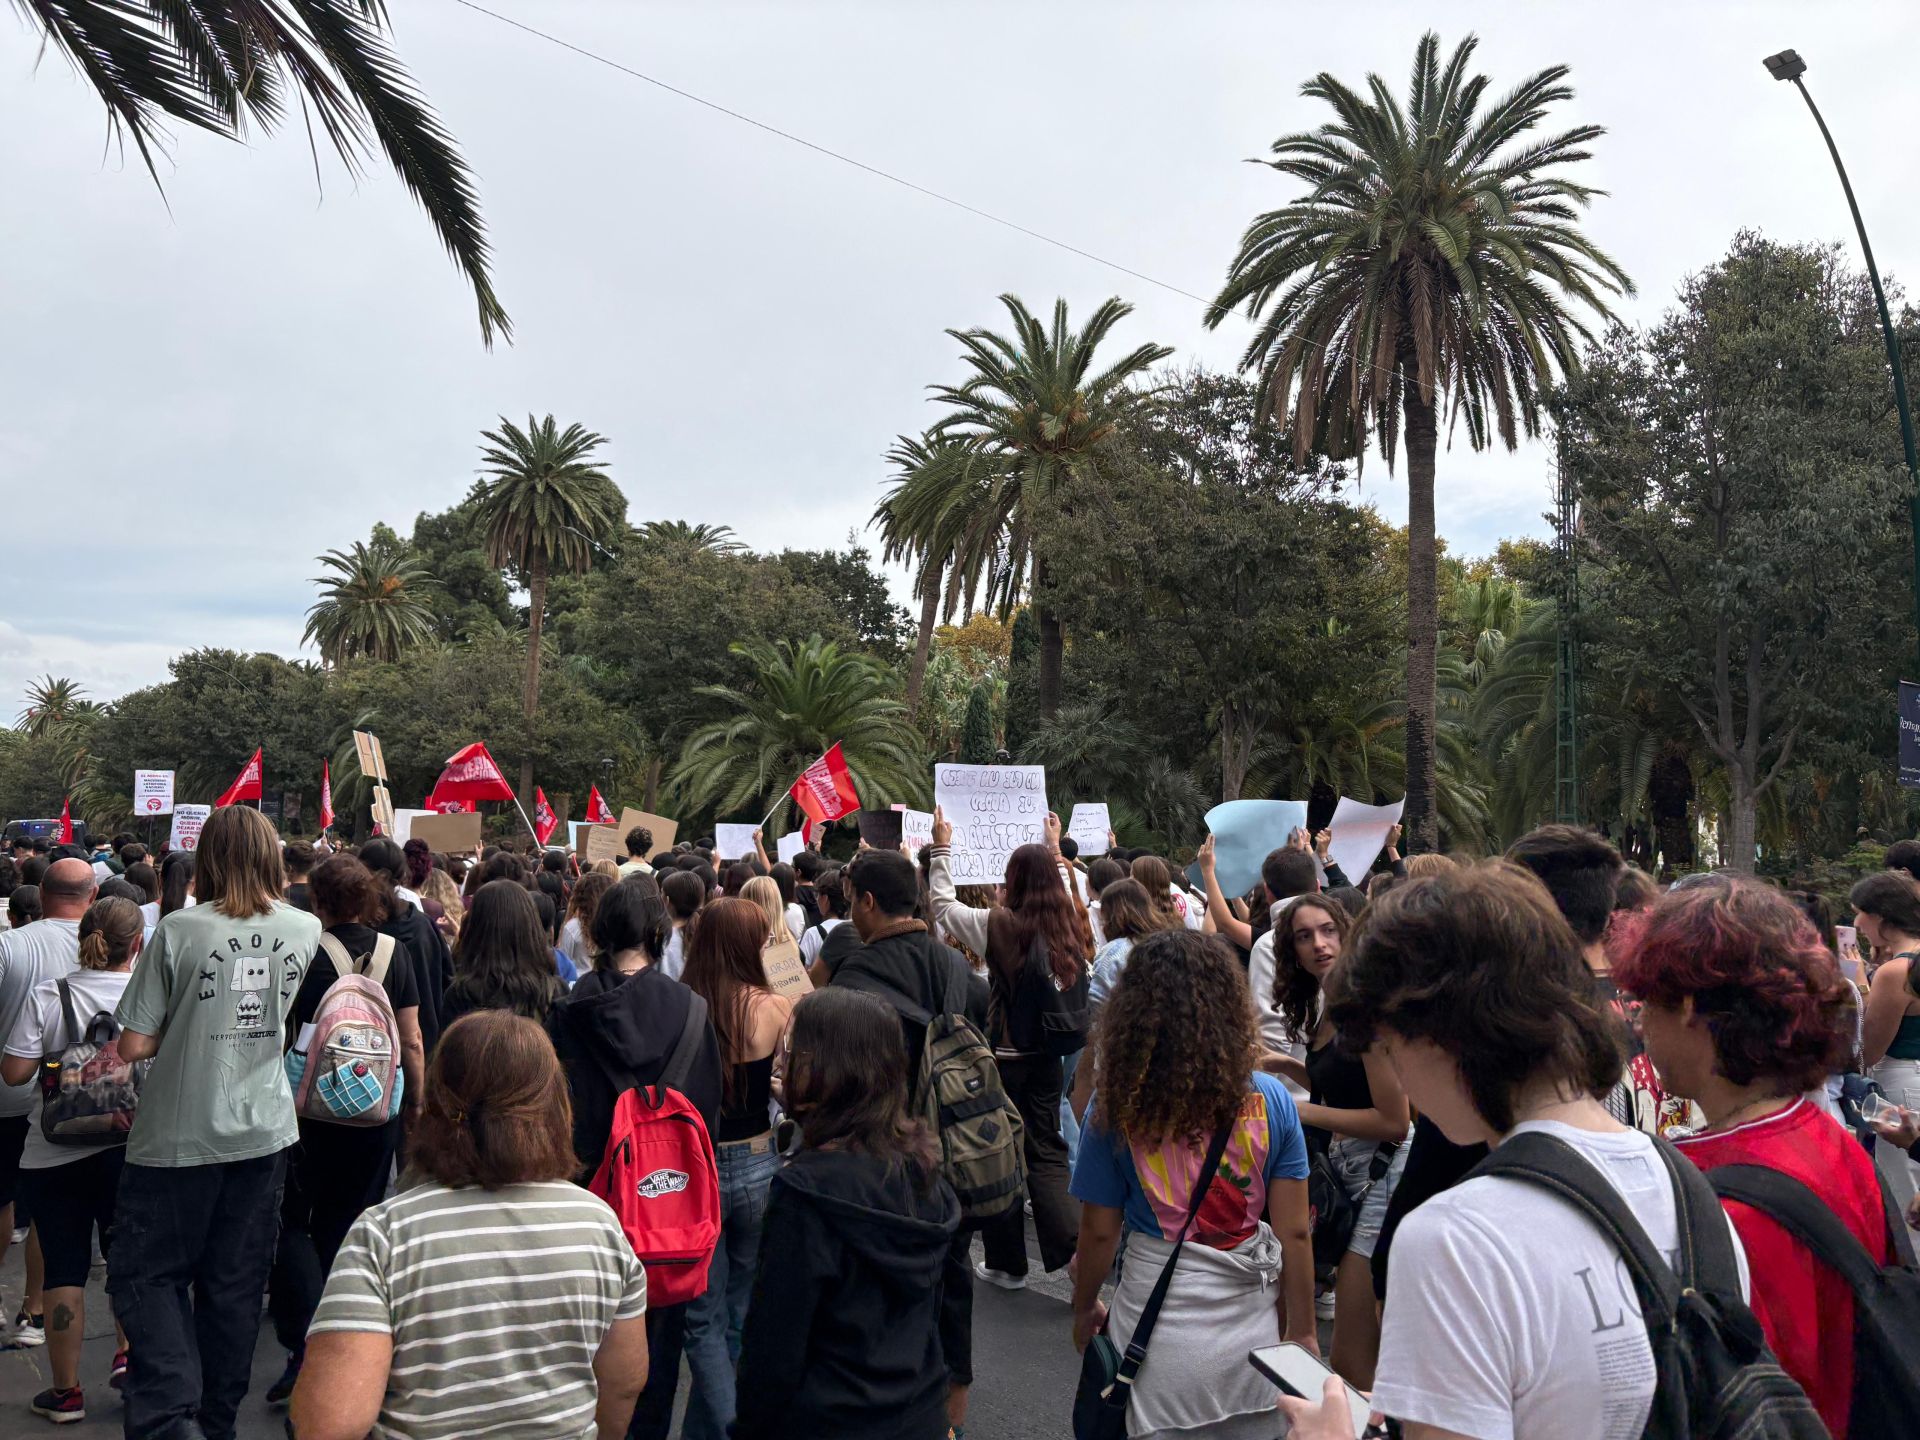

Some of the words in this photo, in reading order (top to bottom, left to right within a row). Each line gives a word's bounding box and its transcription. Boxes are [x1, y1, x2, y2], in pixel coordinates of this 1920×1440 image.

[198, 933, 298, 1001] EXTROVERT
[246, 1030, 278, 1039] NATURE
[649, 1172, 670, 1185] VANS
[655, 1179, 669, 1190] THE
